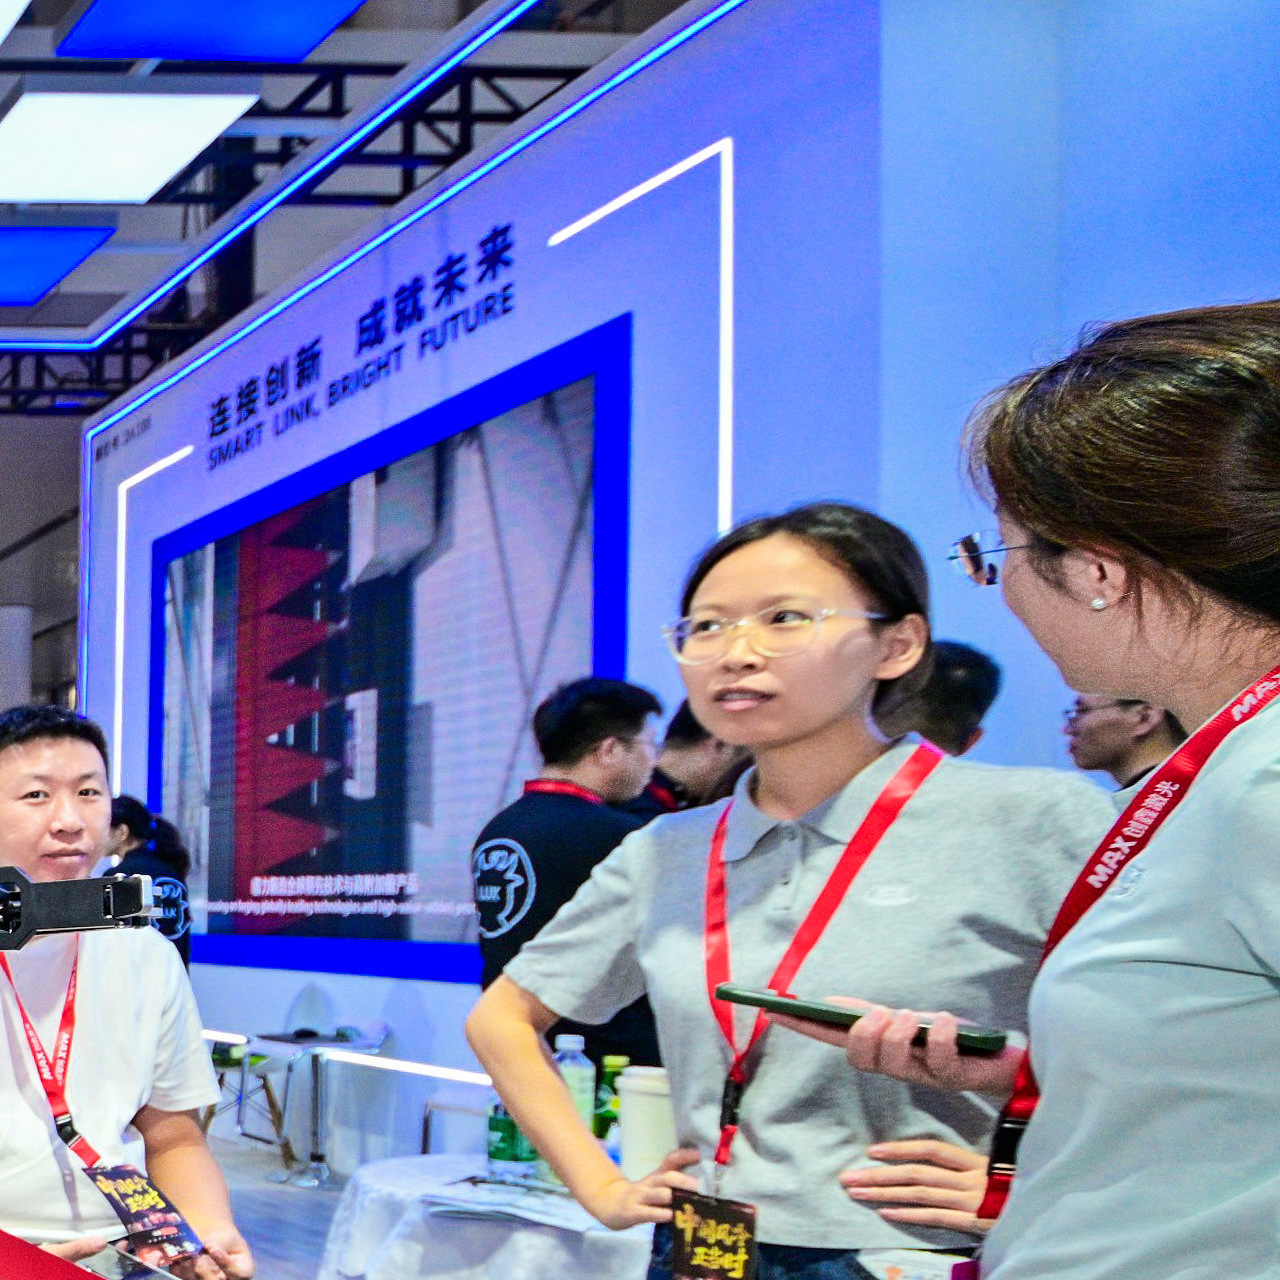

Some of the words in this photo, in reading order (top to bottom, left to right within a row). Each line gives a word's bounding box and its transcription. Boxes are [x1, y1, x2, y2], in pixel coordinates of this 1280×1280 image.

[209, 335, 322, 438] 连接创新
[356, 223, 514, 357] 成就未来
[209, 422, 263, 471] SMART
[328, 342, 406, 408] BRIGHT
[419, 283, 515, 359] FUTURE
[1086, 836, 1138, 889] MAX
